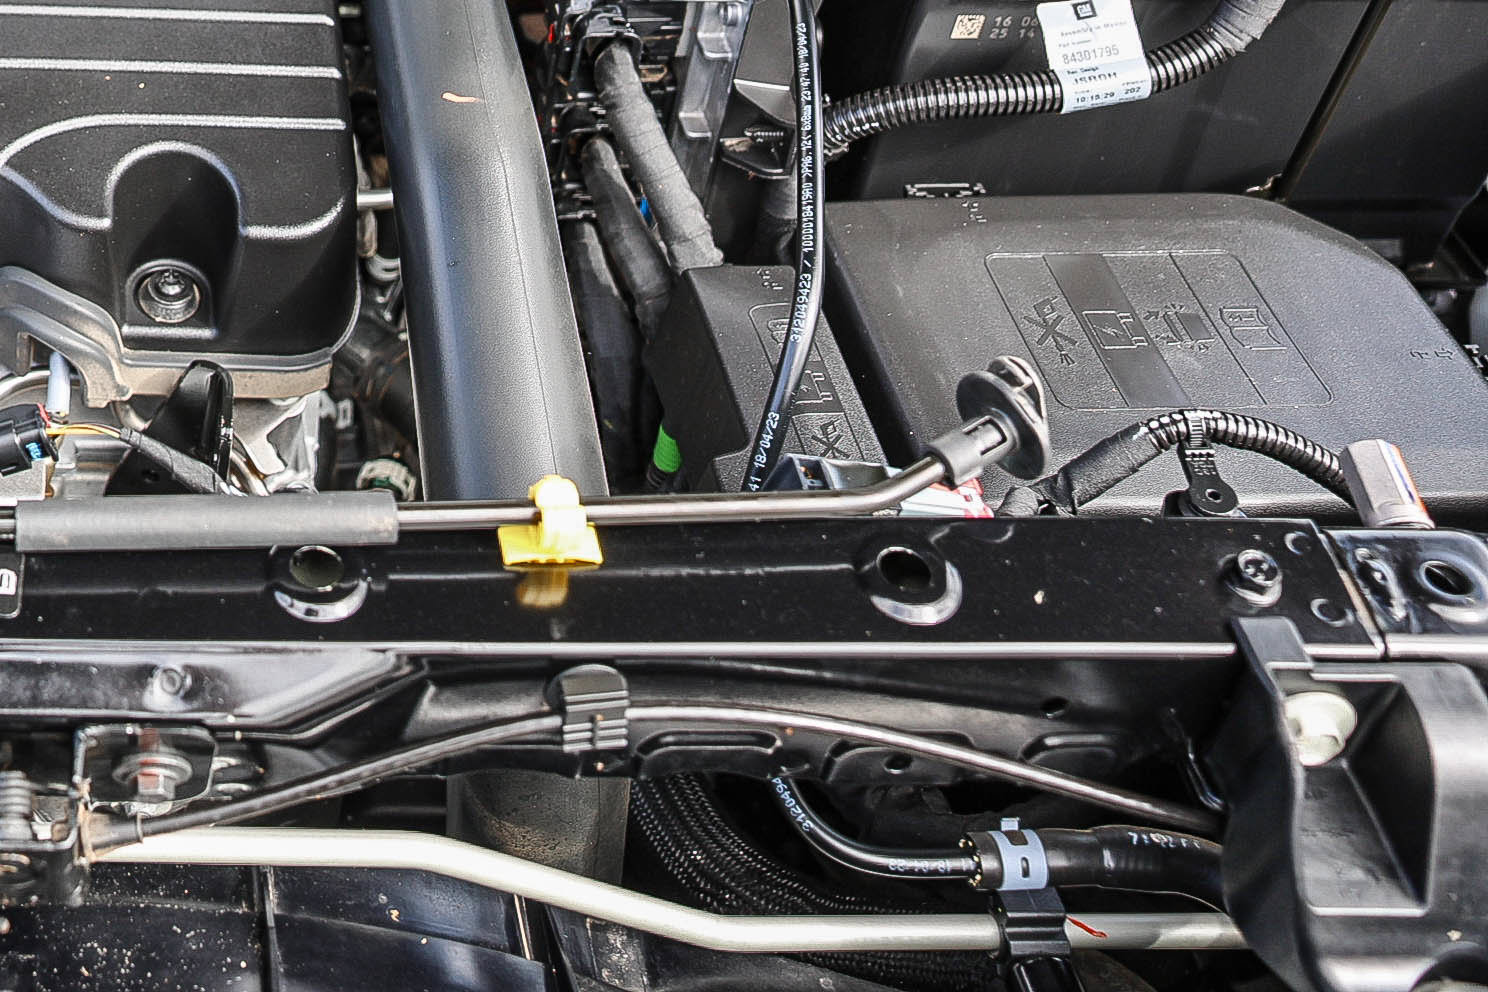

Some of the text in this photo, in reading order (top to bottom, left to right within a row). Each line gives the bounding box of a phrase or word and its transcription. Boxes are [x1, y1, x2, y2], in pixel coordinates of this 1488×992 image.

[989, 27, 1009, 39] 25
[994, 15, 1012, 27] 16
[1062, 44, 1120, 65] 84301795
[789, 273, 812, 343] 312049423
[753, 411, 780, 468] 18/04/23
[771, 776, 814, 832] 3120494
